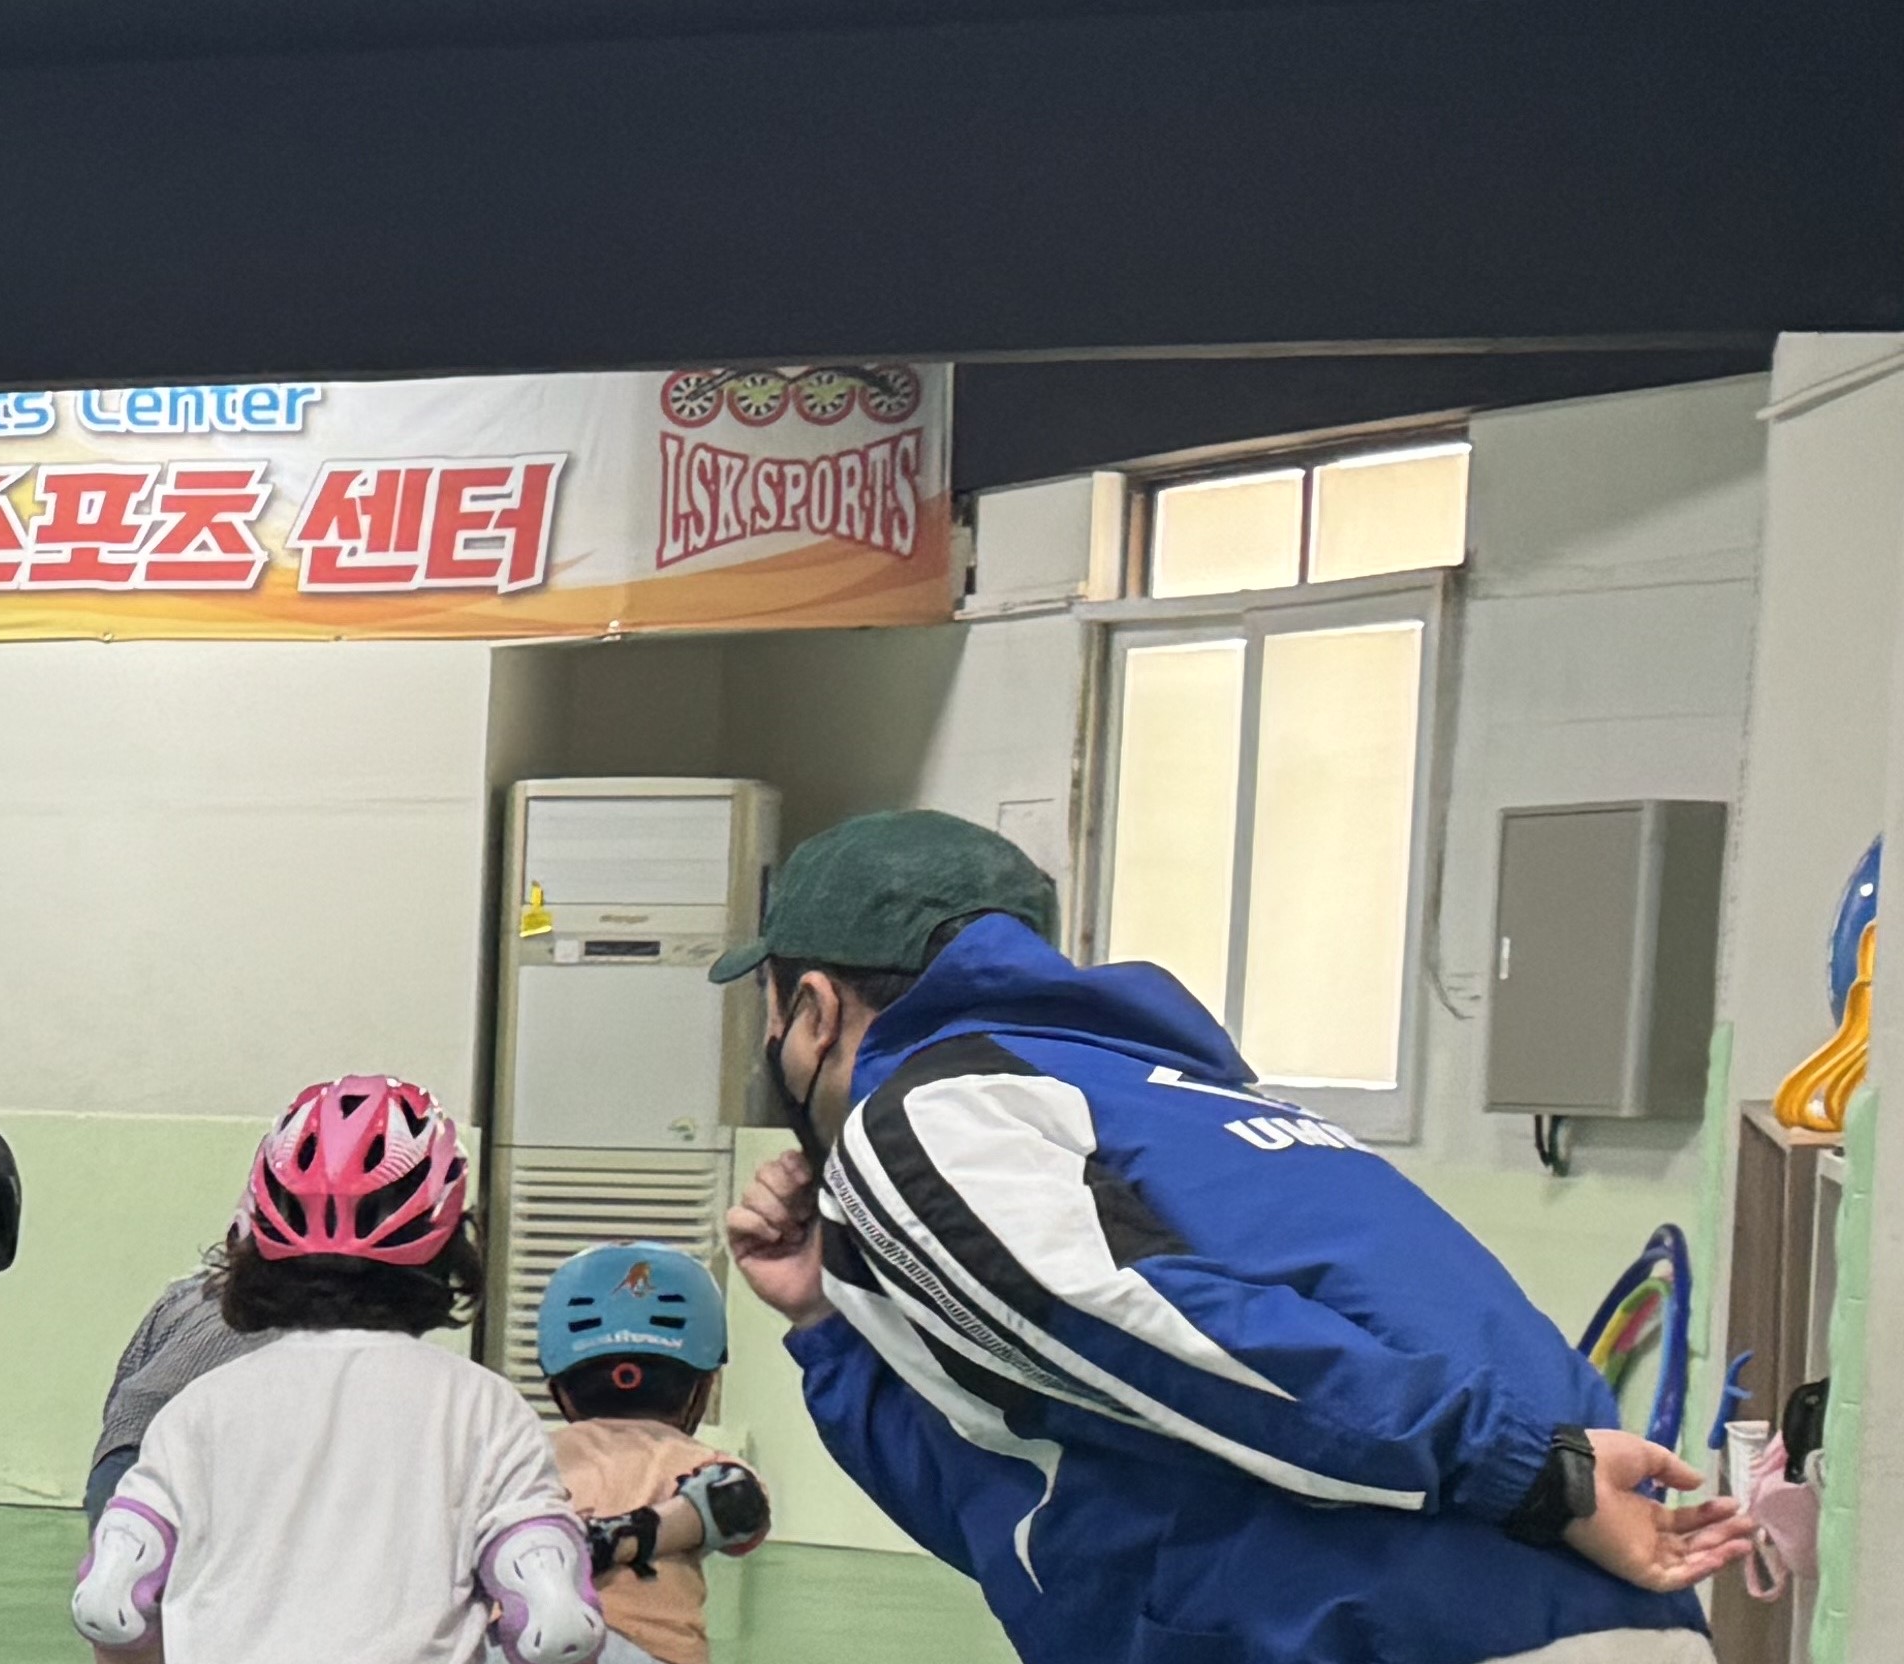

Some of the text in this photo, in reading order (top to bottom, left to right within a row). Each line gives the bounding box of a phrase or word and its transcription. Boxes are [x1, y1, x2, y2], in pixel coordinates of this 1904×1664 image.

[76, 384, 320, 433] Center
[294, 460, 556, 590] 센터
[656, 427, 924, 570] LSK SPORTS
